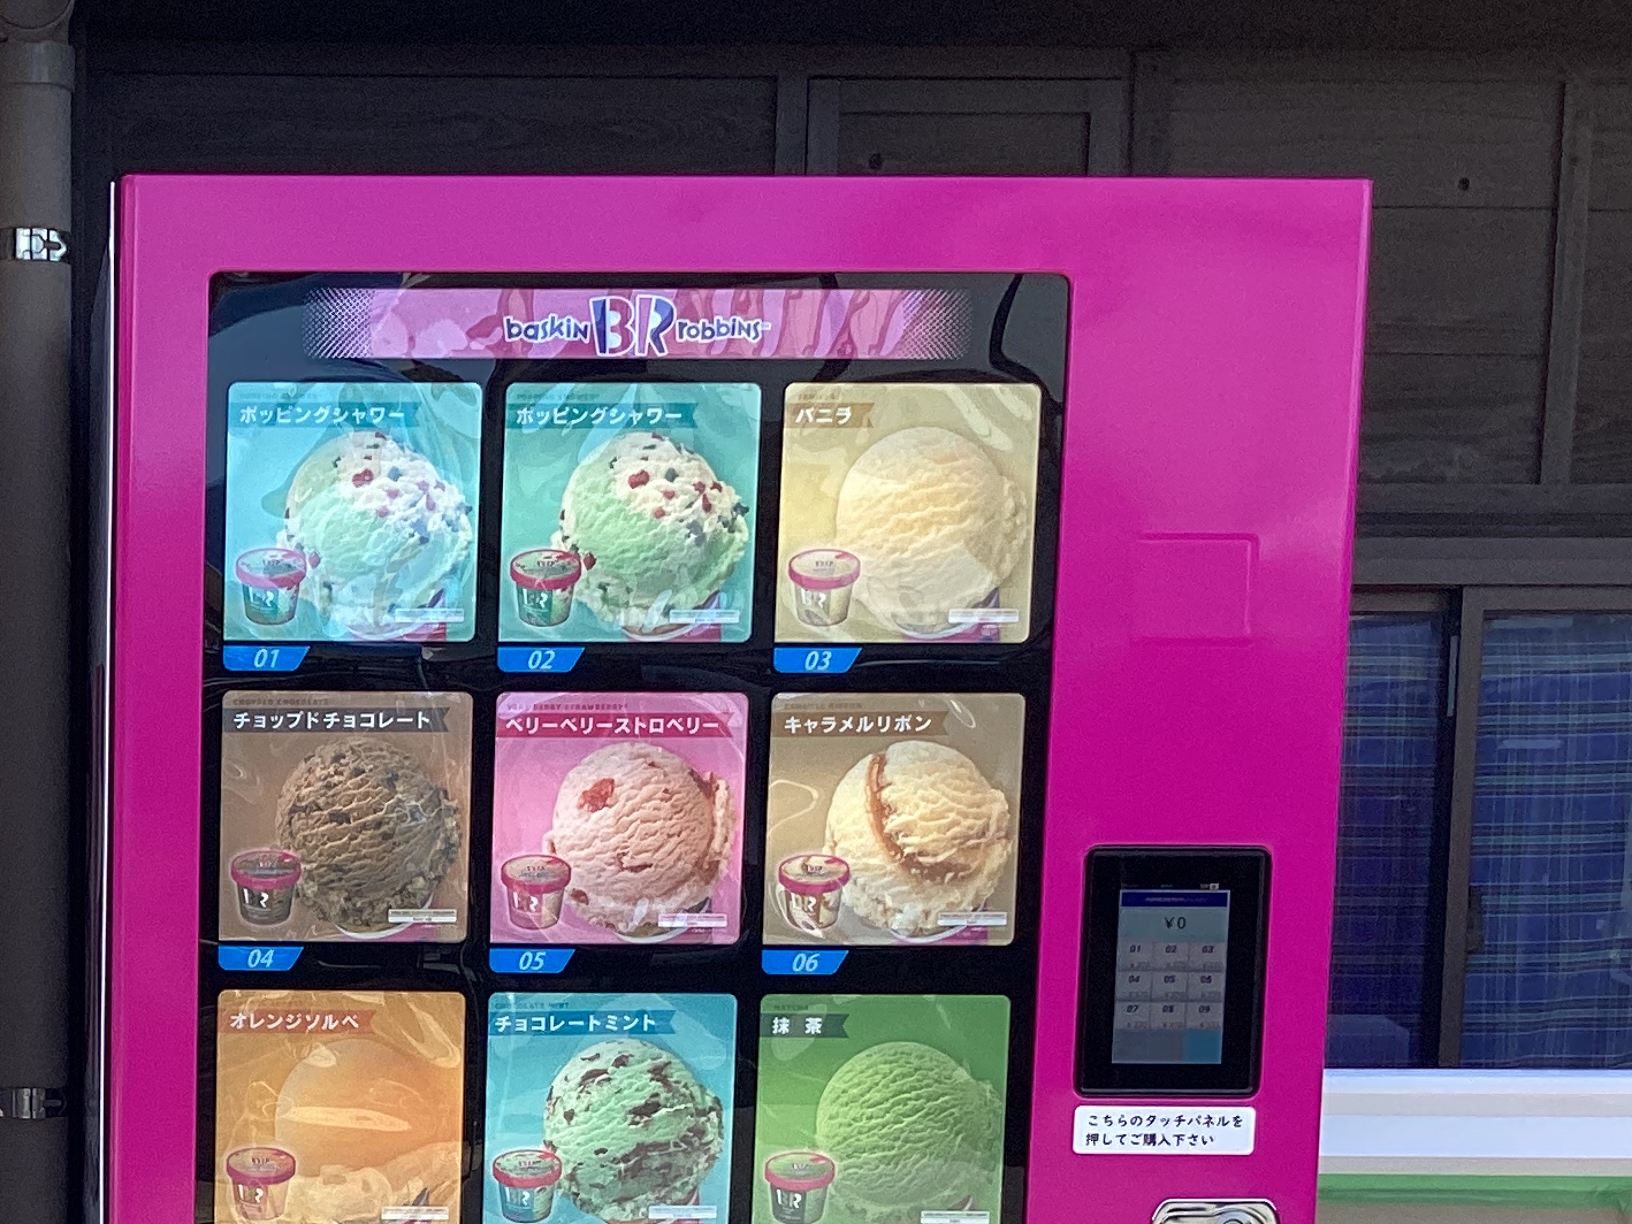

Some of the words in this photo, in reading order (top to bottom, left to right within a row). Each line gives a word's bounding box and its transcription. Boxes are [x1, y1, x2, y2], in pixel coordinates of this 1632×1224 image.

[502, 315, 590, 343] baskin
[588, 294, 676, 357] BR
[675, 319, 763, 342] robbins
[239, 405, 406, 425] ポッピングシャワー
[516, 406, 683, 426] ポッピングシャワー
[794, 405, 853, 425] バニラ
[253, 648, 279, 669] 01
[527, 649, 556, 670] 02
[804, 650, 833, 671] 03
[505, 716, 720, 735] ベリーベリーストロベリー
[783, 714, 933, 734] キャラメルリボン
[247, 948, 275, 968] 04
[518, 951, 547, 971] 05
[791, 952, 820, 972] 06
[229, 1012, 360, 1031] オレンジソルベ
[494, 1014, 657, 1033] チョコレートミント
[771, 1016, 823, 1035] 抹茶
[1088, 1113, 1243, 1128] こちらのタッチパネルを
[1085, 1133, 1215, 1148] 押してご購入下さい
